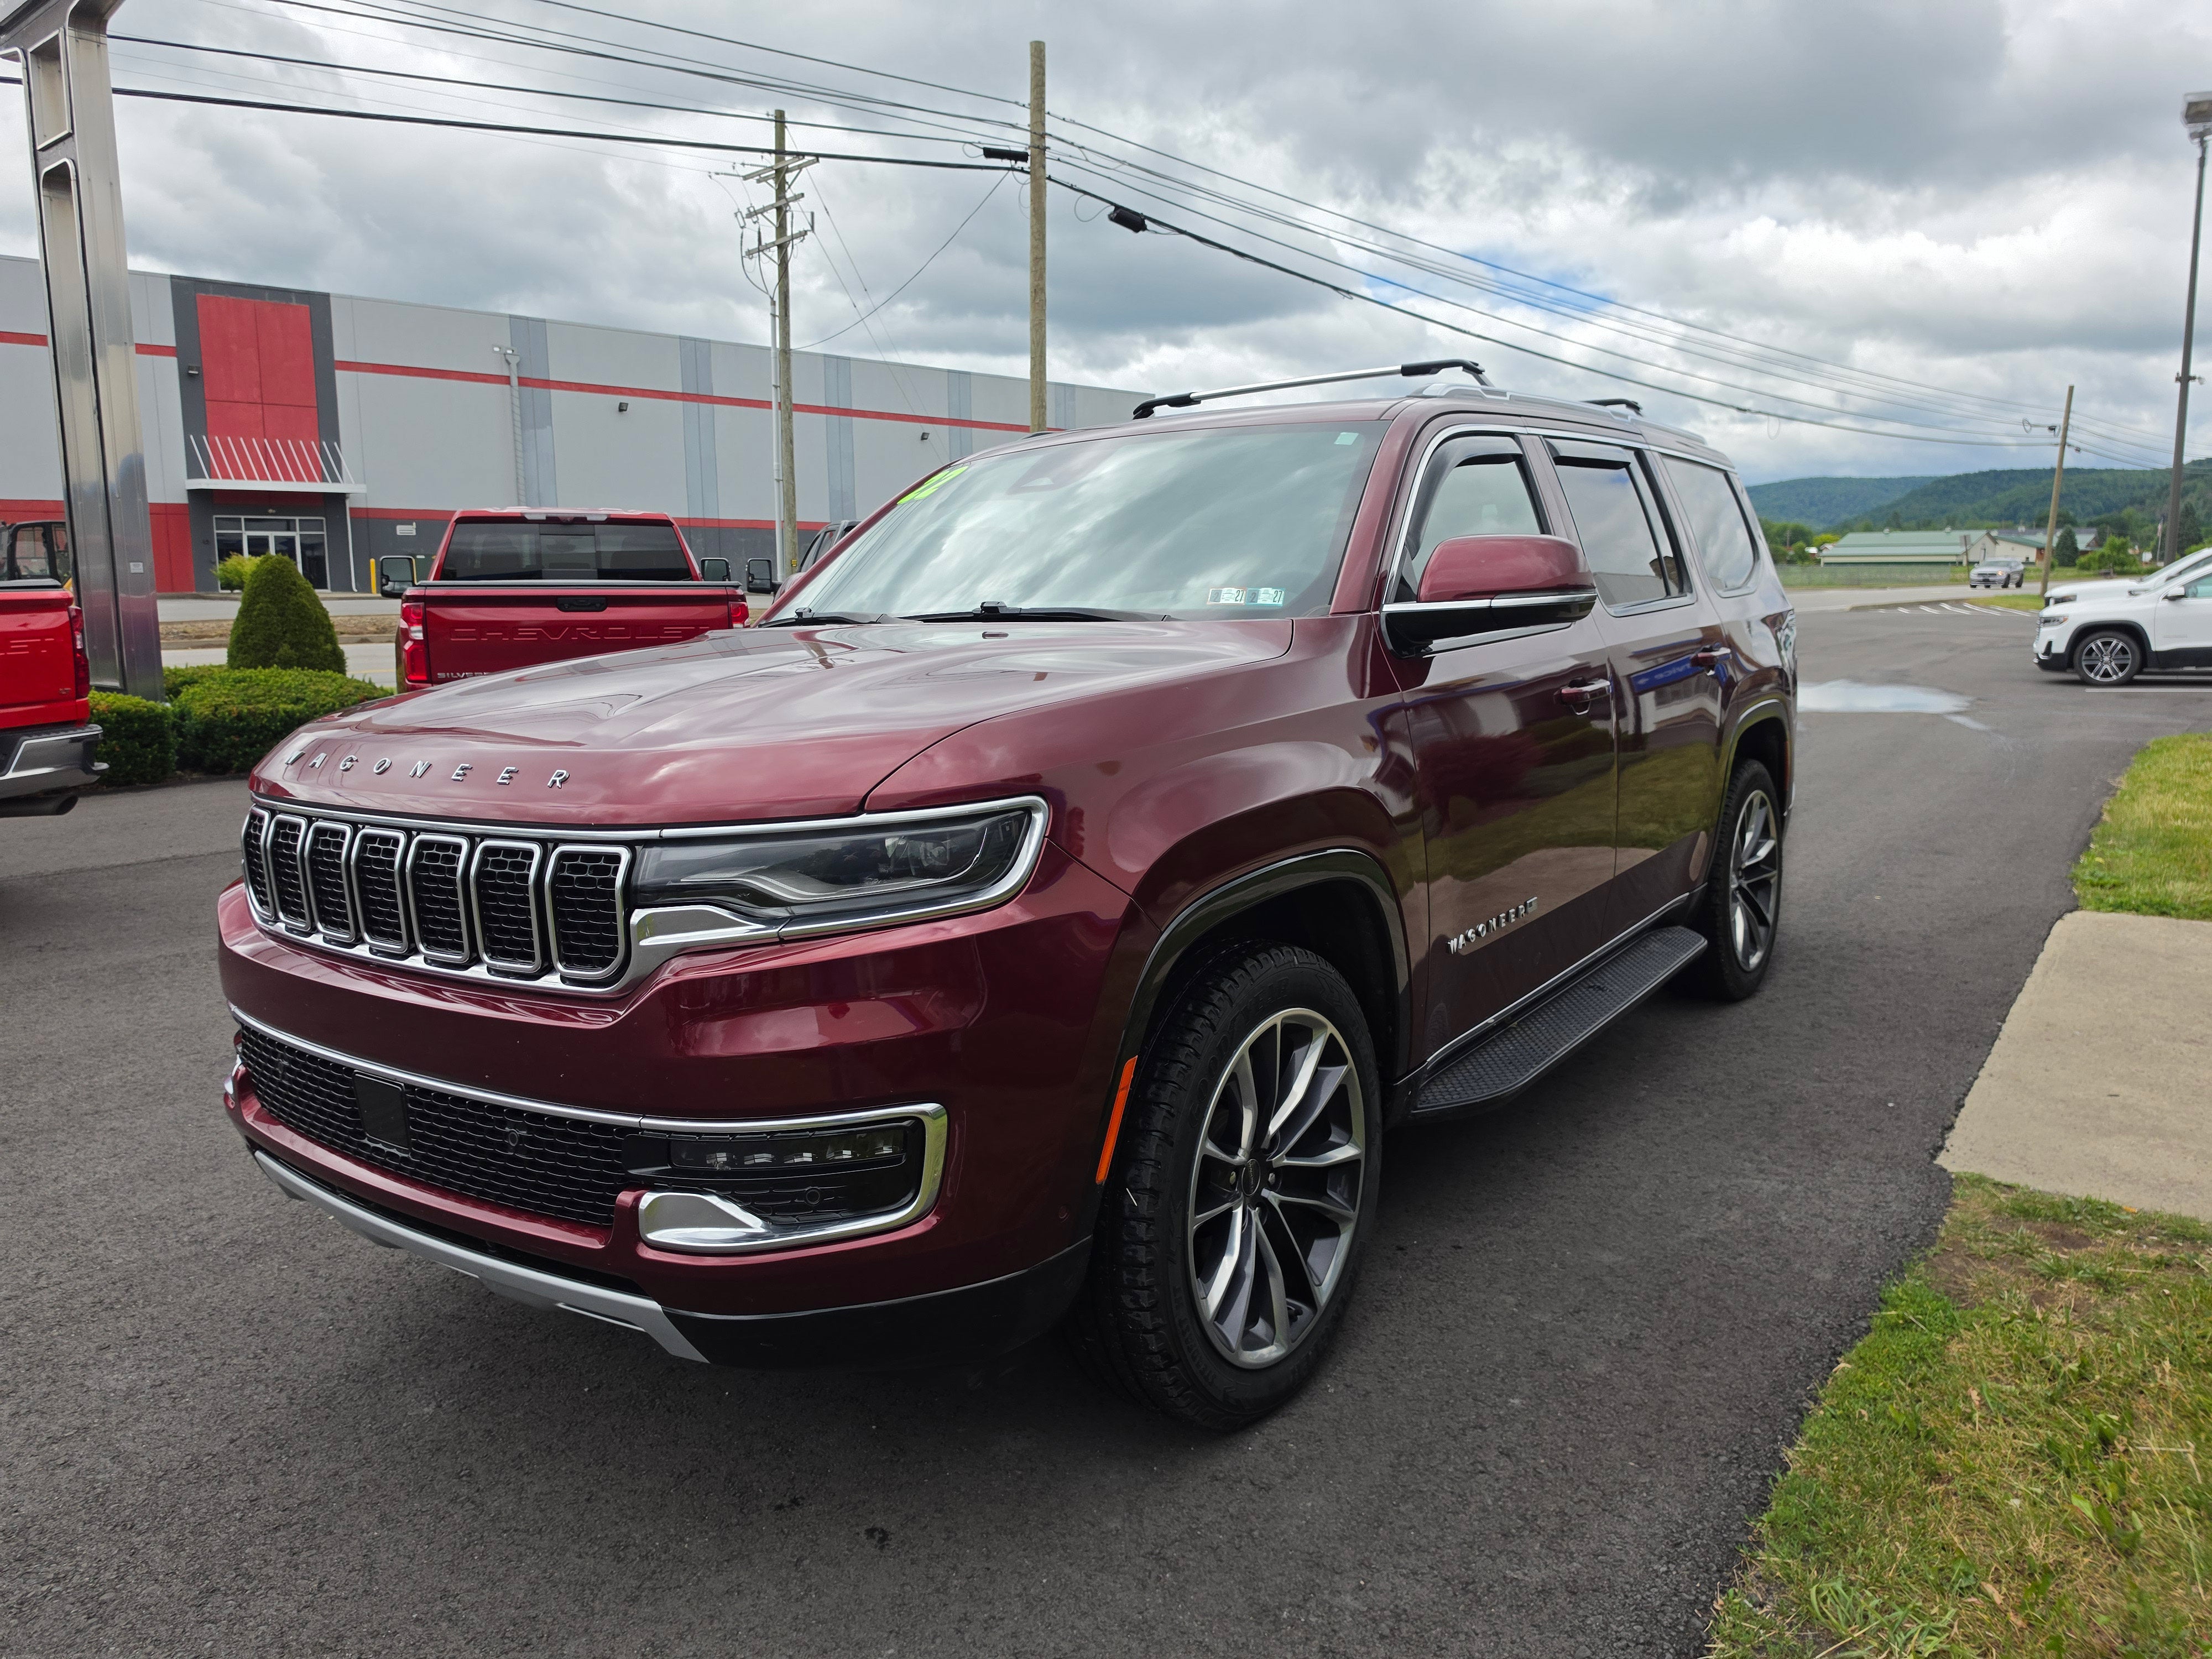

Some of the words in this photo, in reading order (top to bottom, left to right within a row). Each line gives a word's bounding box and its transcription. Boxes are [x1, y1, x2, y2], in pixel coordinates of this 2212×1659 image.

[1235, 589, 1244, 603] 27
[1272, 590, 1282, 603] 27
[451, 626, 710, 641] CHEVROLET
[284, 750, 570, 789] WAGONEER
[1447, 905, 1525, 954] WAGONEER
